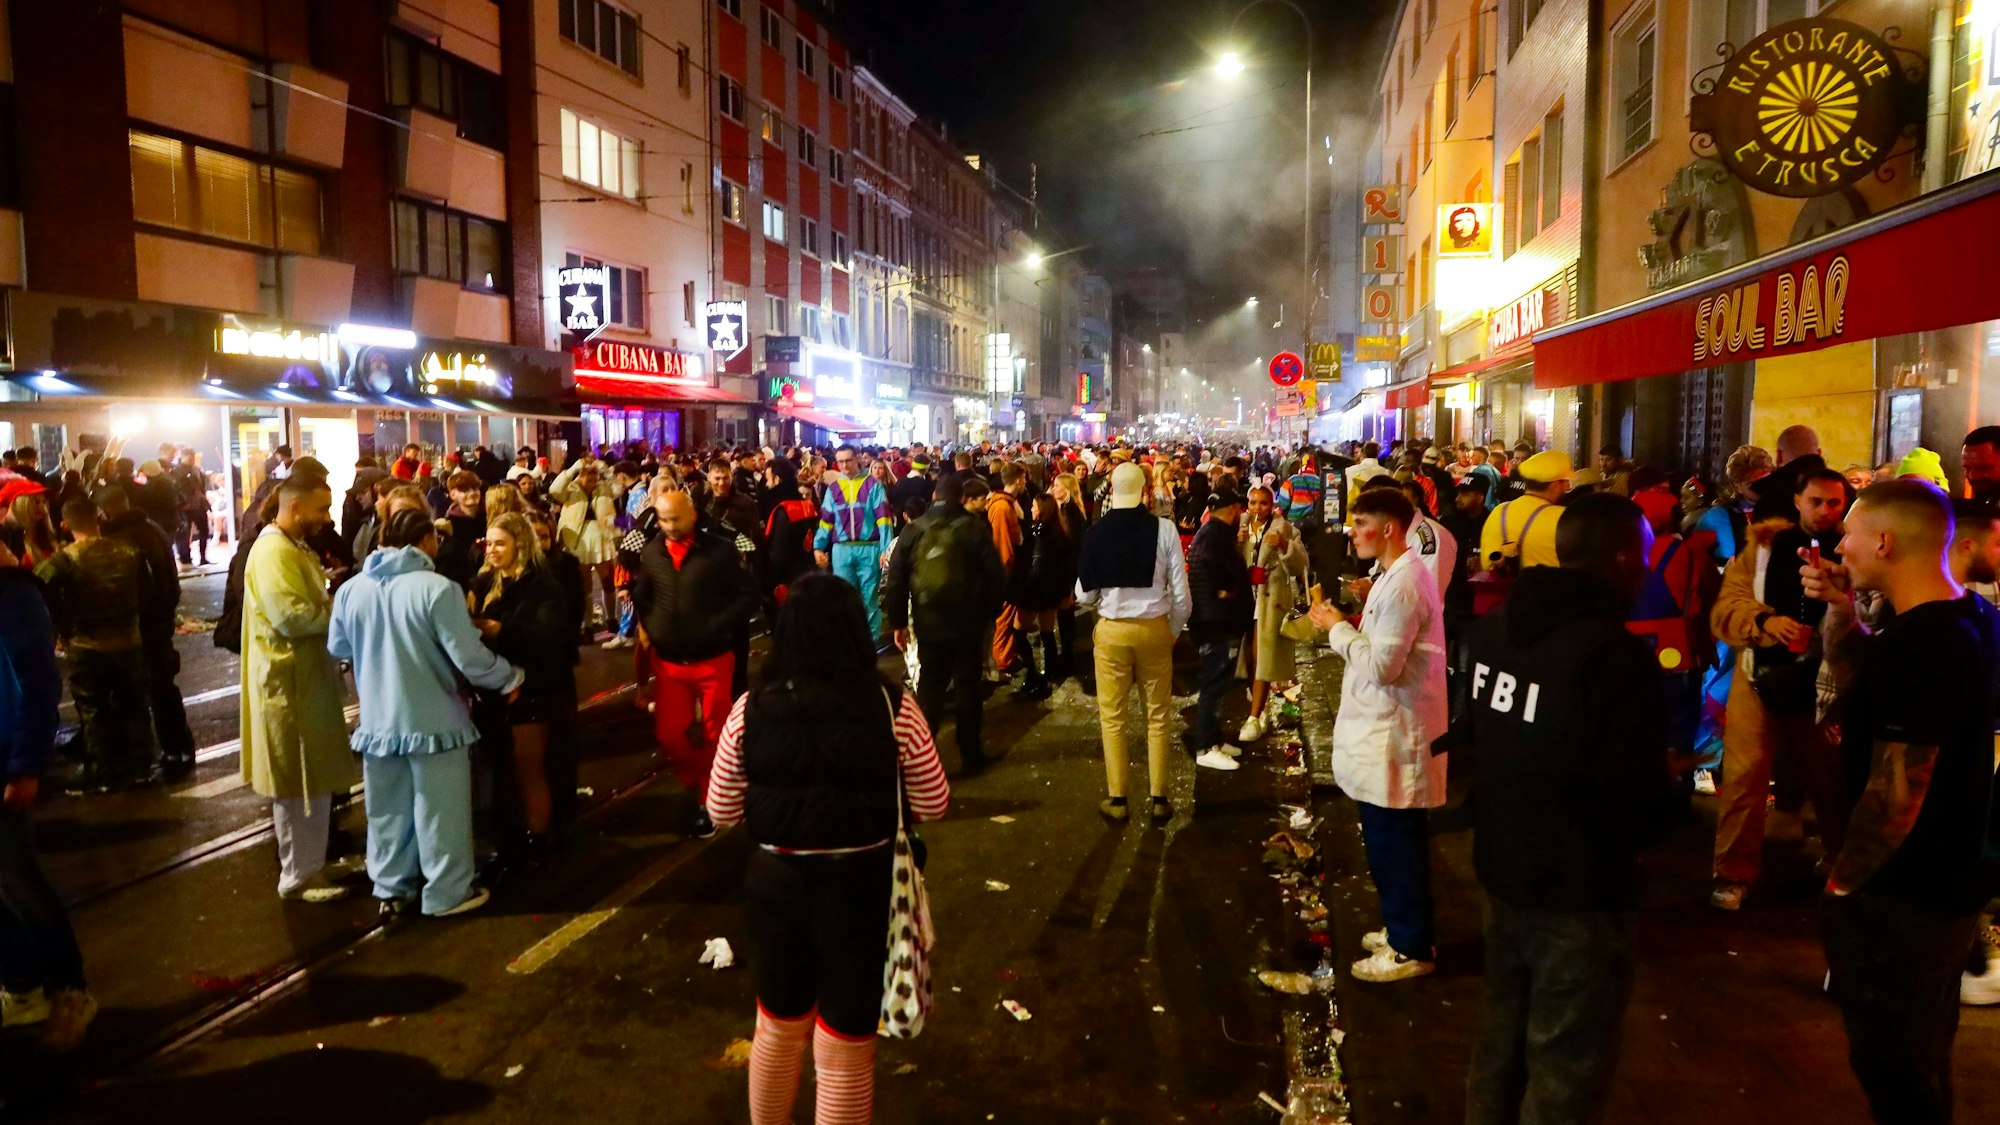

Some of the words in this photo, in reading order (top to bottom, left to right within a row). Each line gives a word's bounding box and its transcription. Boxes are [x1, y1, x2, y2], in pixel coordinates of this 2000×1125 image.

[1727, 27, 1892, 94] RISTORANTE
[559, 267, 604, 286] CUBANA
[566, 315, 599, 330] BAR
[1493, 303, 1519, 347] CUBA
[1520, 288, 1544, 337] BAR
[1693, 282, 1766, 361] SOUL
[1773, 256, 1850, 347] BAR
[596, 341, 659, 373] CUBANA
[1471, 661, 1541, 724] FBI
